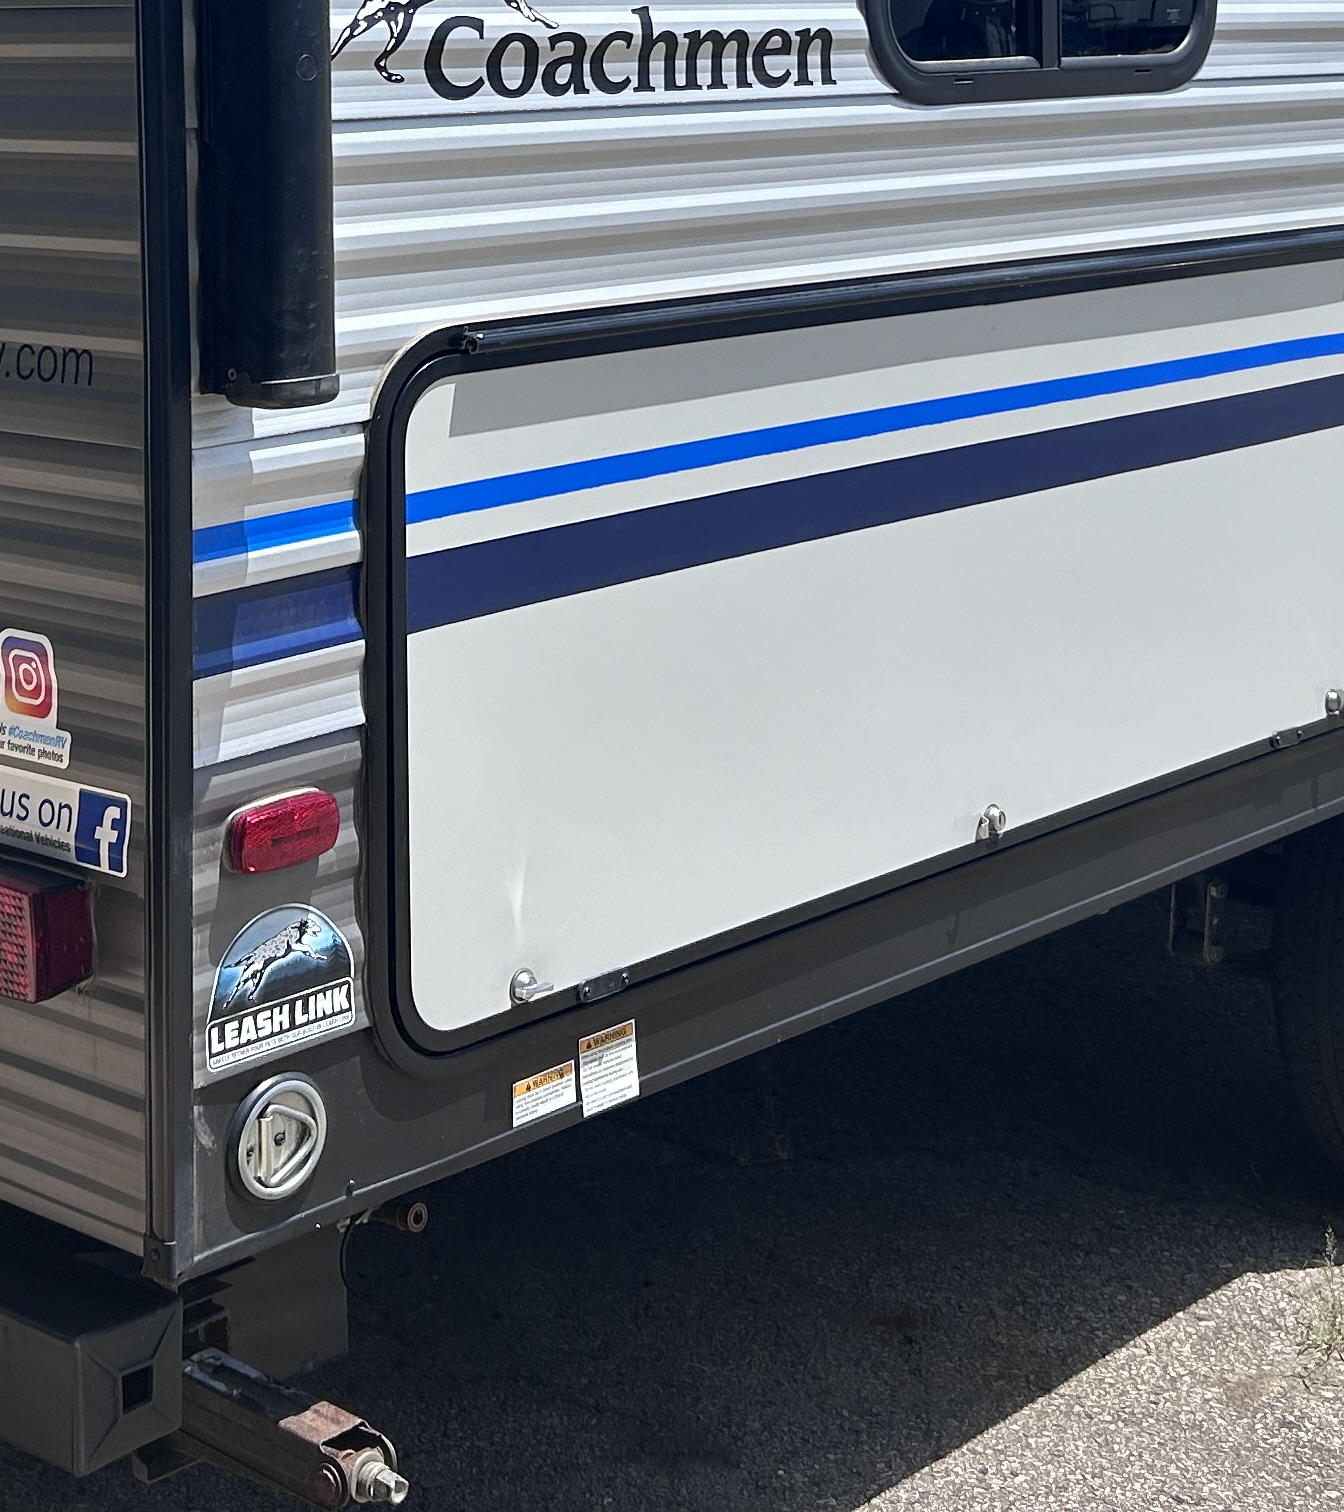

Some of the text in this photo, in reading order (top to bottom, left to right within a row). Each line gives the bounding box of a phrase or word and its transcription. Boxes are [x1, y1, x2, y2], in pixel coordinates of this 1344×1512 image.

[423, 5, 838, 101] Coachmen
[6, 739, 36, 757] favorite
[37, 747, 64, 764] photos
[8, 724, 68, 749] #CoachmenRV
[0, 788, 31, 821] us
[38, 798, 73, 832] on
[35, 831, 71, 853] Vehicles
[210, 984, 351, 1055] LEASH LINK
